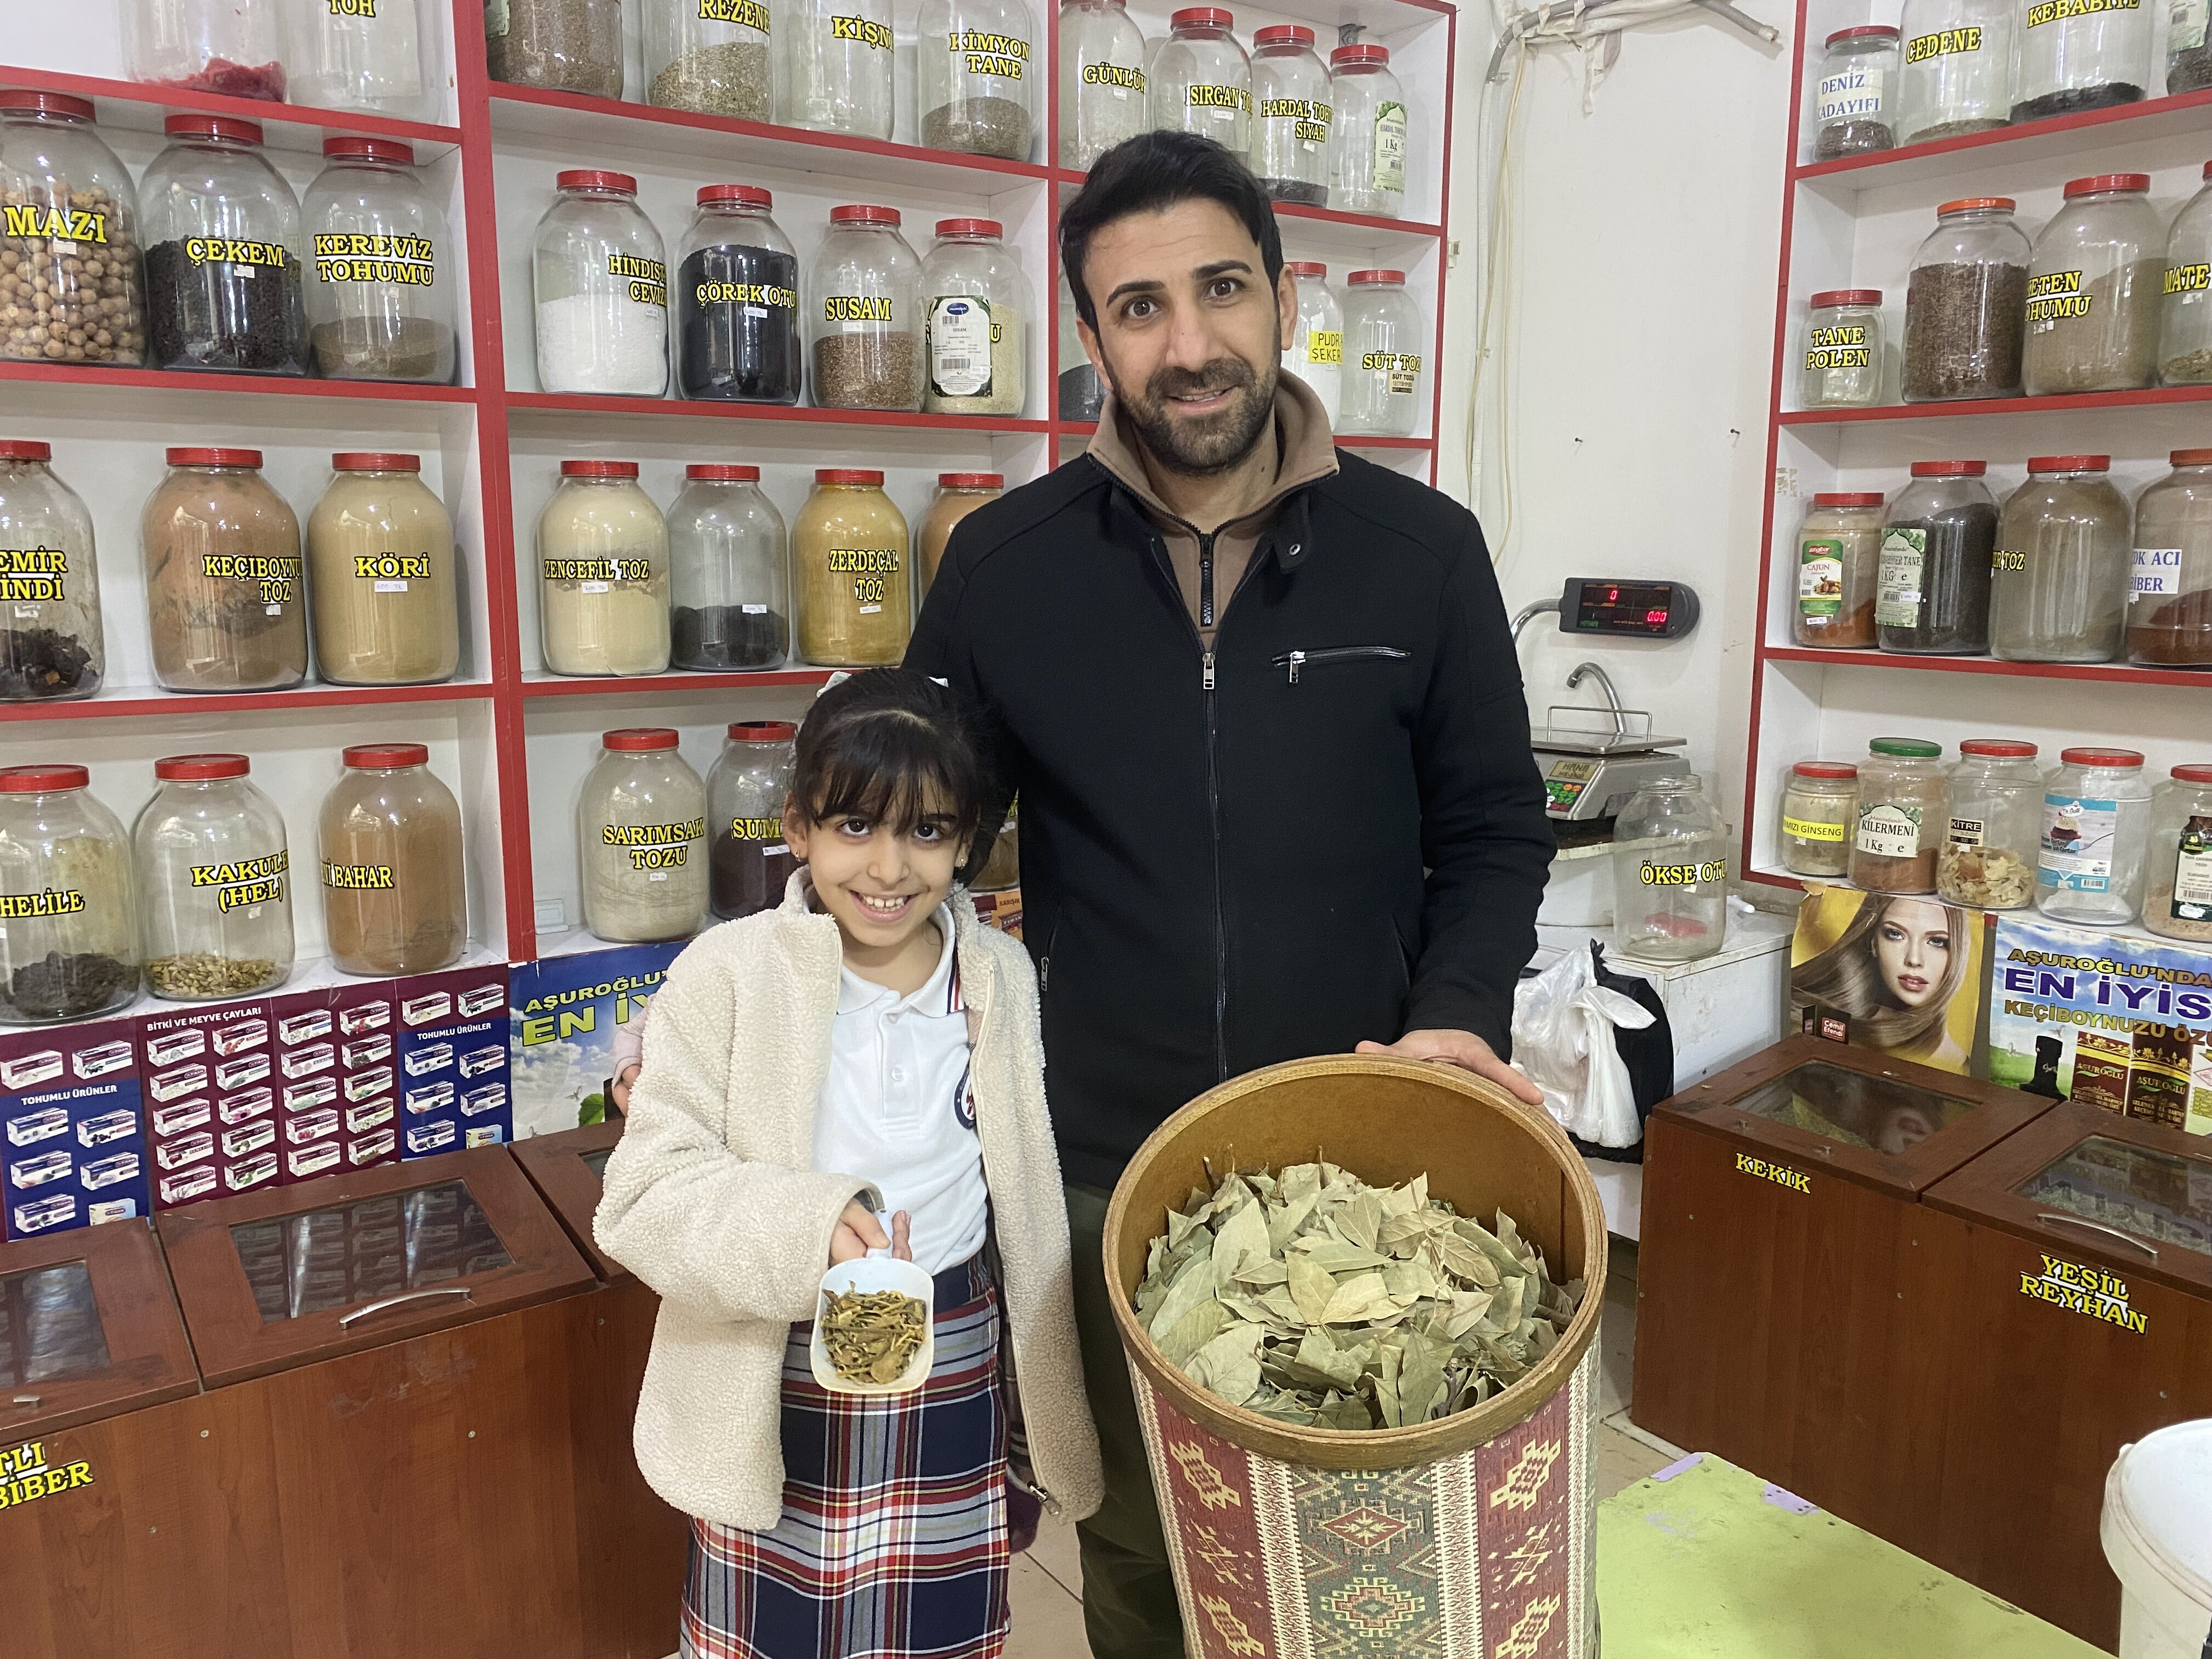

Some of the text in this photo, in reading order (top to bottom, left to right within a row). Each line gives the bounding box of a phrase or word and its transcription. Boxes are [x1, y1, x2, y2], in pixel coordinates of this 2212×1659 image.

[950, 29, 1030, 62] KİMYON
[1906, 27, 1982, 64] CEDENE
[966, 55, 1022, 80] TANE
[1822, 73, 1864, 94] DENİZ
[1261, 99, 1311, 118] HARDAL
[3, 205, 107, 243] MAZI
[185, 237, 286, 270] ÇEKEM
[314, 232, 433, 261] KEREVİZ
[317, 258, 435, 287] TOHUMU
[696, 279, 796, 309] ÇÖREK OTU
[825, 296, 892, 321] SUSAM
[1811, 326, 1866, 348] TANE
[1362, 351, 1396, 370] SÜT
[1806, 349, 1870, 370] POLEN
[203, 555, 303, 581] KEÇİBOYNU
[354, 552, 431, 578] KÖRİ
[544, 556, 650, 580] ZENCEFİL TOZ
[829, 549, 899, 577] ZERDEÇAL
[2004, 551, 2025, 571] TOZ
[2151, 551, 2181, 566] ACI
[259, 579, 292, 603] TOZ
[855, 578, 884, 601] TOZ
[1610, 590, 1617, 600] 0
[603, 817, 704, 845] SARIMSAK
[1801, 825, 1841, 836] GİNSENG
[1861, 818, 1914, 837] KİLERMENİ
[1951, 820, 1981, 831] KİTRE
[630, 845, 687, 870] TOZU
[1871, 839, 1883, 853] Kg
[191, 849, 289, 887] KAKULE
[333, 864, 394, 889] BAHAR
[1640, 860, 1697, 885] ÖKSE
[0, 888, 85, 919] HELİLE
[218, 876, 284, 913] (HEL)
[2008, 949, 2212, 989] AŞUROĞLU'NDA
[2005, 967, 2076, 1001] EN
[147, 1007, 261, 1031] BİTKİ VE MEYVE ÇAYLARI
[417, 1022, 492, 1041] TOHUMLU ÜRÜNLER
[522, 1005, 596, 1047] EN
[2005, 999, 2166, 1039] KEÇİBOYNUZU
[21, 1084, 117, 1106] TOHUMLU ÜRÜNLER
[1735, 1152, 1811, 1194] KEKİK
[2040, 1253, 2130, 1302] YEŞİL
[2019, 1271, 2149, 1335] REYHAN
